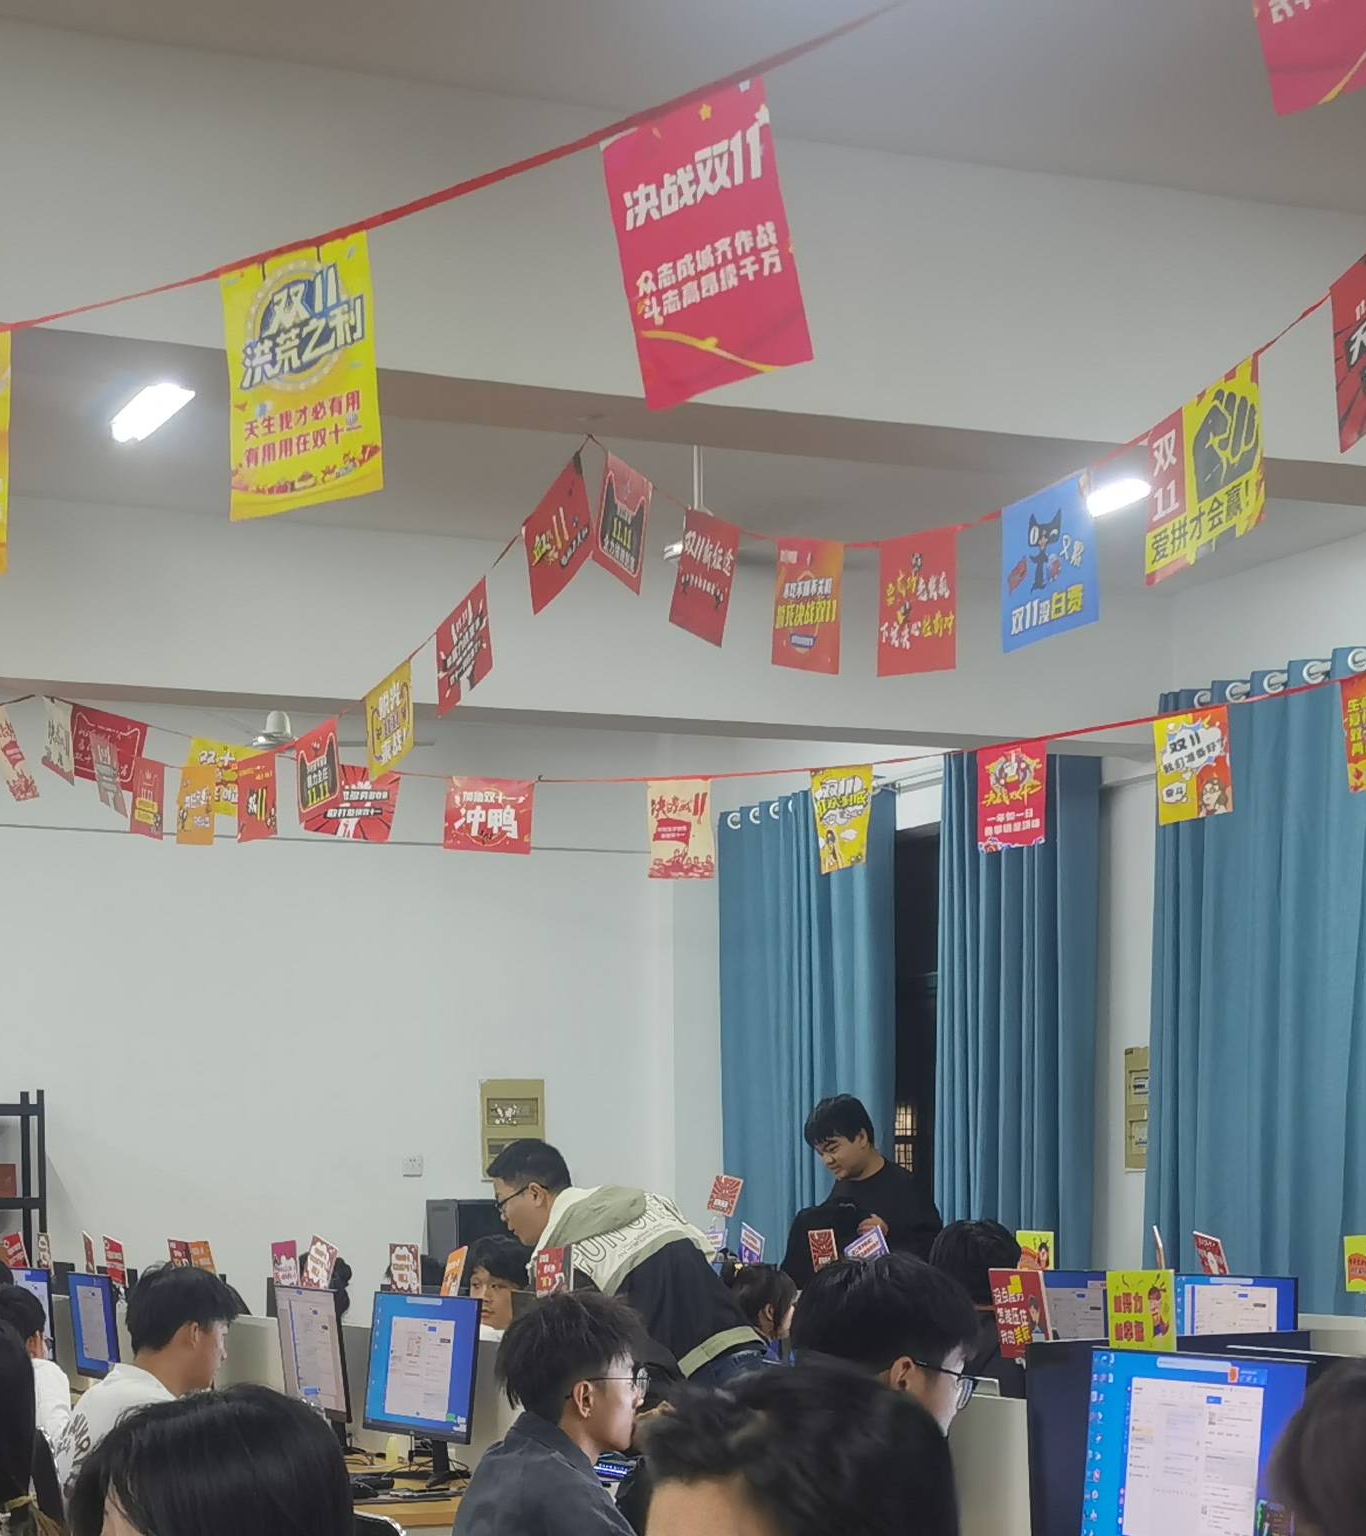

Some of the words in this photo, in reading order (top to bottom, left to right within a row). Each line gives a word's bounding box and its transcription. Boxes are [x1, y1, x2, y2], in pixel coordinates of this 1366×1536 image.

[623, 123, 764, 231] 决战双11
[636, 221, 777, 297] 众志成城齐作战
[263, 263, 340, 338] 双11
[240, 294, 367, 391] 洪荒之利
[244, 390, 361, 440] 天生我才必有用
[245, 423, 363, 469] 有用用在双十一
[1151, 479, 1250, 565] 爱拼才会赢!
[1162, 737, 1225, 774] 我们准备好了
[1169, 730, 1202, 755] 双11
[307, 783, 330, 806] 11.11
[454, 806, 520, 840] 冲鸭
